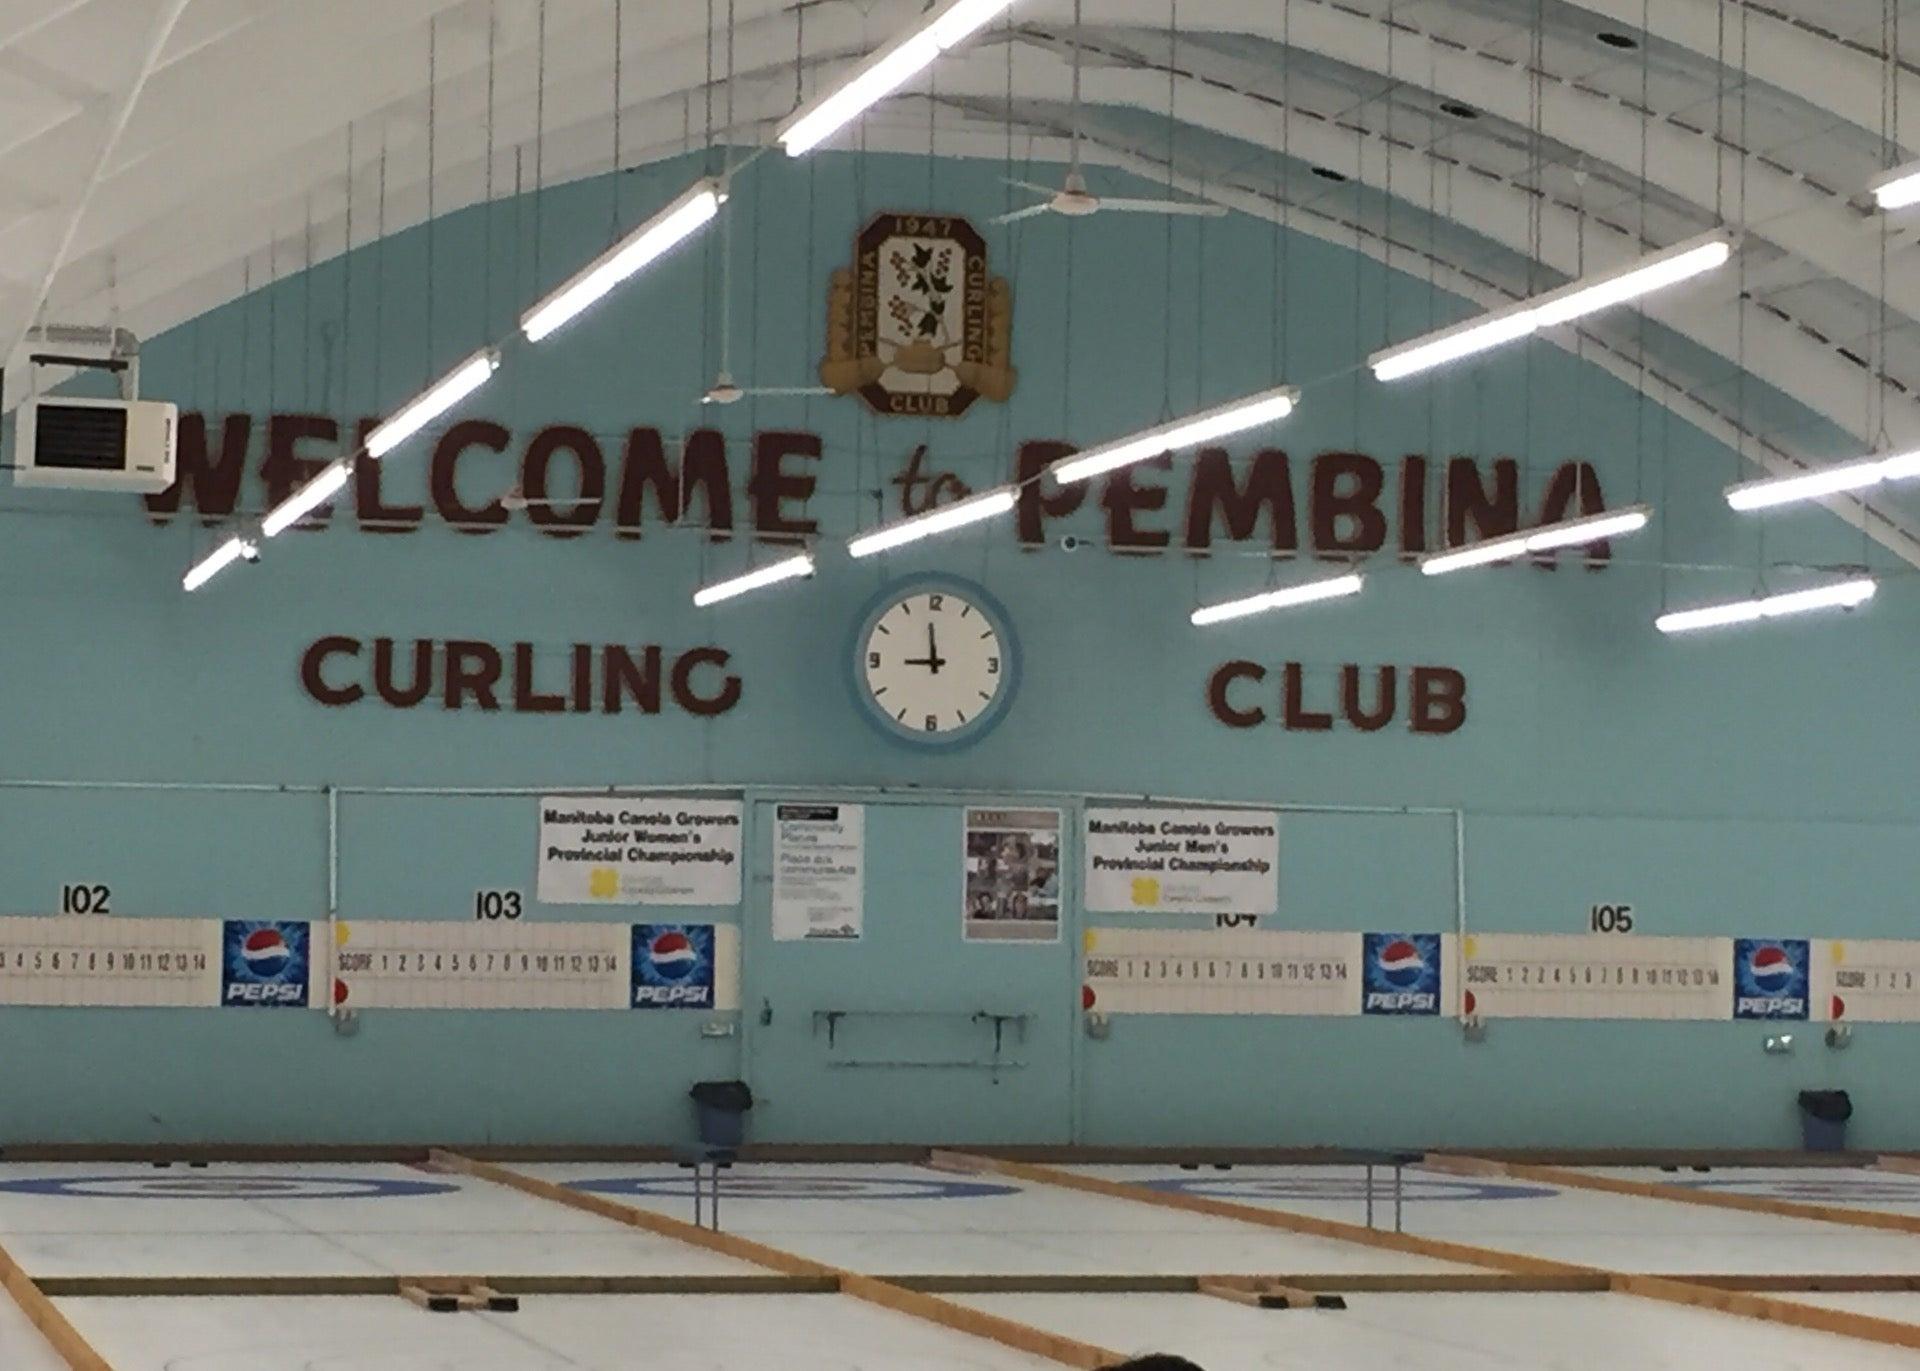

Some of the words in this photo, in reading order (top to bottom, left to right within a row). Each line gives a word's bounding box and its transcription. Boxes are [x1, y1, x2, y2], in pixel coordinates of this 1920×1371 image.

[895, 219, 952, 236] 1947
[966, 256, 984, 363] CURLING
[890, 395, 949, 412] CLUB
[145, 412, 822, 546] WELCOME
[893, 444, 971, 516] to
[1017, 440, 1611, 568] PEMBINA
[929, 595, 943, 611] 12
[869, 652, 880, 668] 9
[987, 657, 998, 674] 3
[300, 635, 742, 716] CURLING
[1206, 660, 1466, 734] CLUB
[925, 715, 937, 731] 6
[544, 809, 614, 825] Manitoba
[618, 810, 672, 826] Canola
[676, 811, 739, 826] Growers
[582, 829, 629, 843] Junior
[634, 830, 701, 843] Women's
[1089, 821, 1155, 835] Manitoba
[1160, 821, 1211, 836] Canola
[1216, 822, 1275, 837] Growers
[1135, 840, 1180, 853] Junior
[1185, 840, 1229, 854] Men's
[547, 847, 622, 862] Provincial
[627, 847, 734, 865] Championship
[1093, 857, 1164, 871] Provincial
[1169, 858, 1270, 874] Championship
[63, 885, 110, 914] 102
[476, 891, 522, 919] 103
[1591, 905, 1633, 933] 105
[339, 953, 372, 971] SCORE
[1087, 960, 1118, 977] SCORE
[227, 983, 304, 1000] PEPSI
[635, 986, 709, 1003] PEPSI
[1367, 993, 1435, 1010] PEPSI
[1738, 997, 1804, 1014] PEPSI
